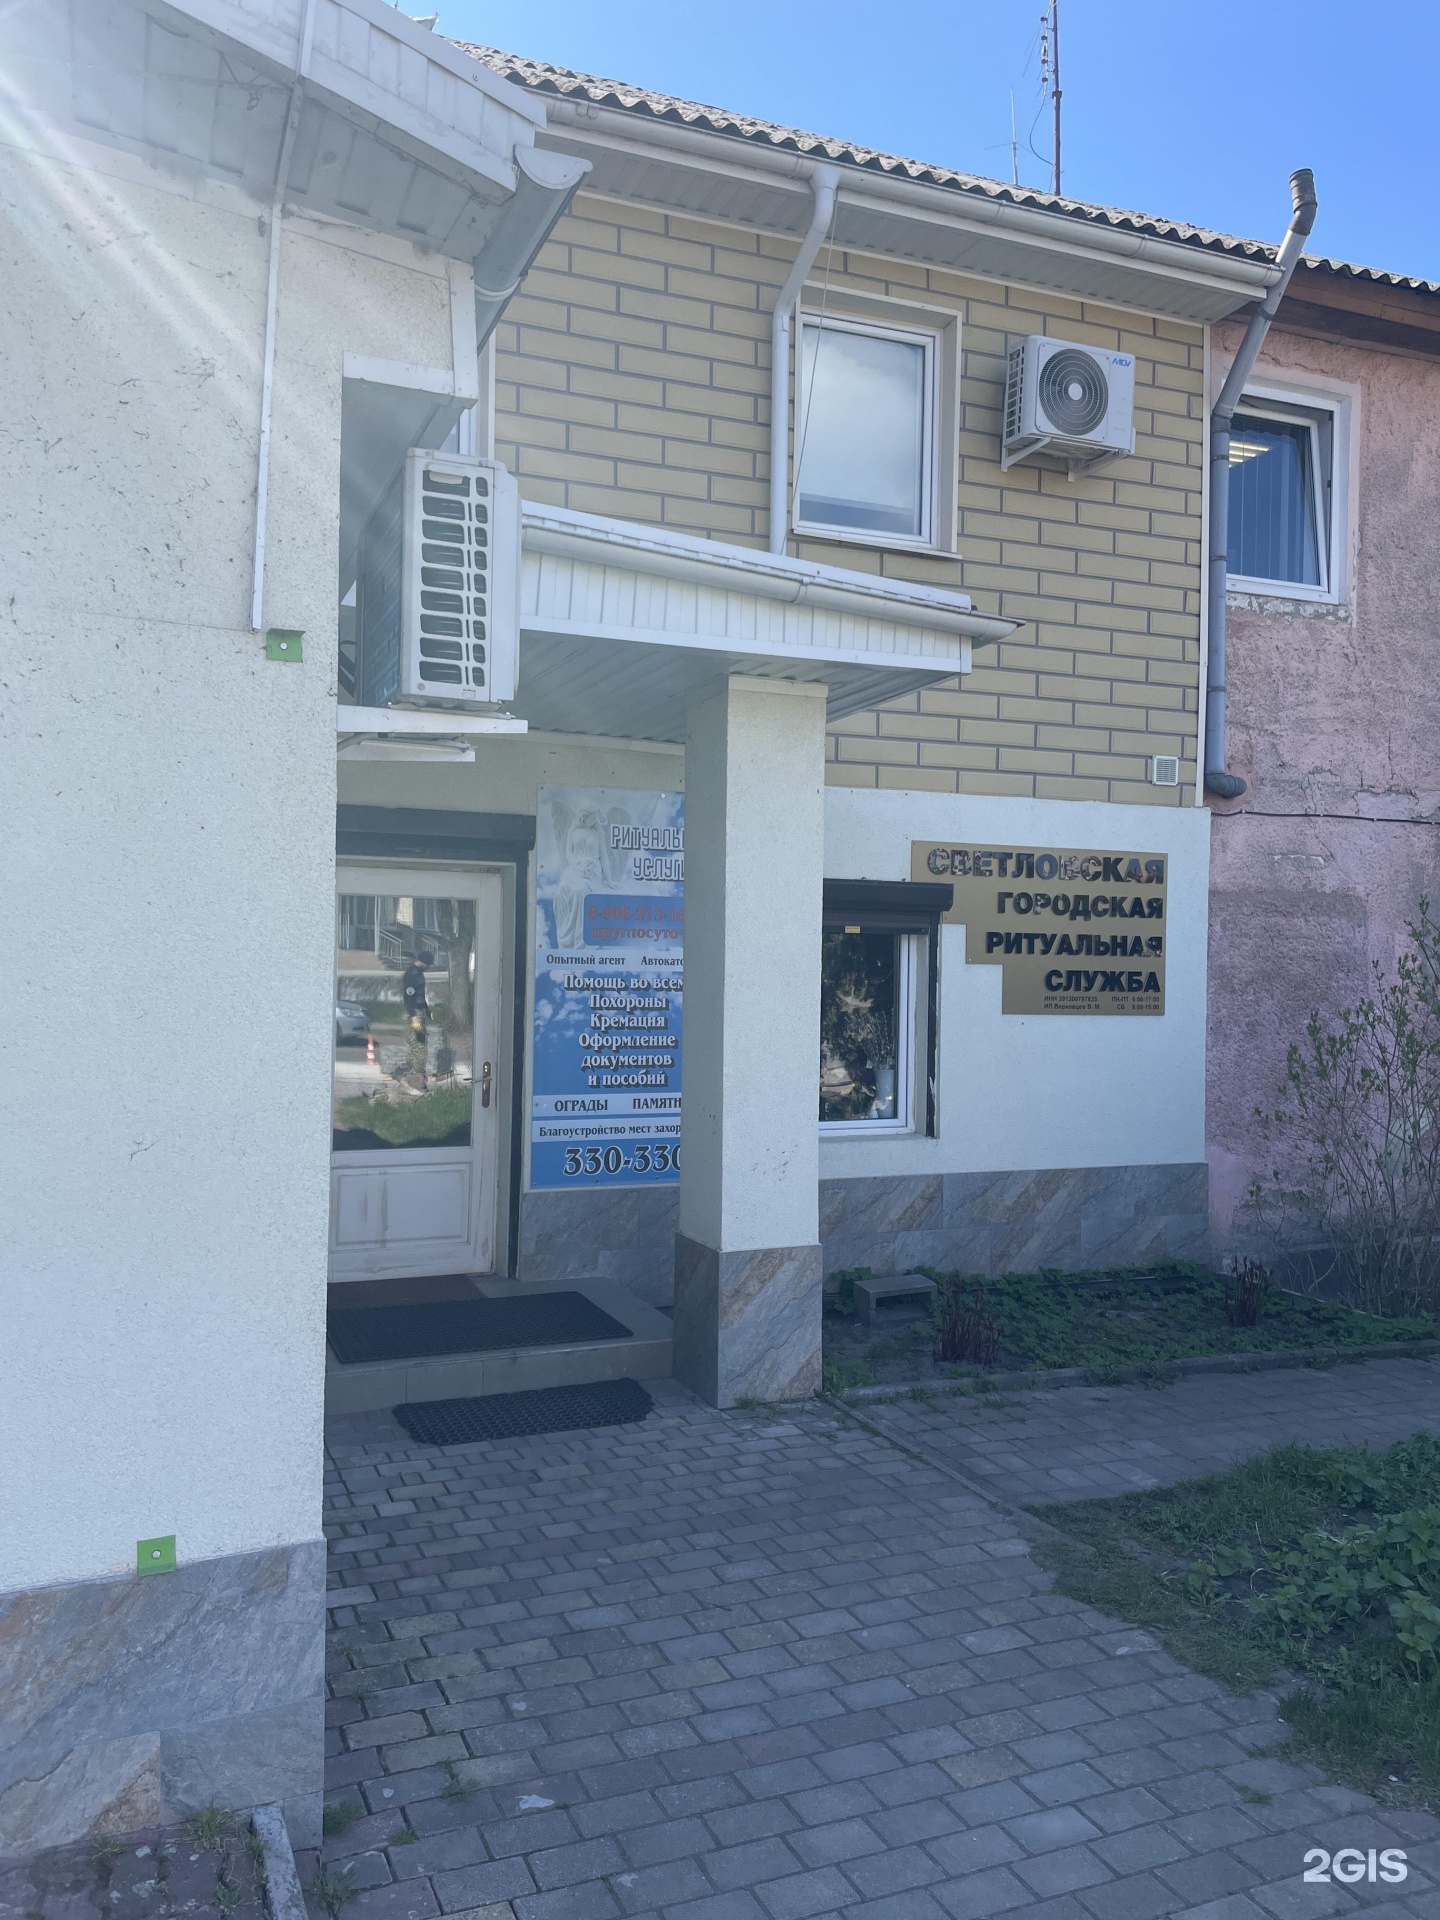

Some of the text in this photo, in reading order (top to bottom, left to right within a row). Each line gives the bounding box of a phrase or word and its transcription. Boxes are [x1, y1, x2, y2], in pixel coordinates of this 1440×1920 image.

[1111, 357, 1131, 367] MDV
[927, 848, 1164, 884] СВЕТЛОВСКАЯ
[997, 892, 1163, 921] ГОРОДСКАЯ
[986, 931, 1163, 957] РИТУАЛЬНАЯ
[546, 954, 595, 965] Опытный
[598, 957, 626, 966] агент
[563, 974, 626, 991] Помощь
[630, 978, 648, 989] во
[1045, 969, 1161, 992] СЛУЖБА
[589, 994, 667, 1011] Похороны
[590, 1013, 665, 1030] Кремация
[578, 1033, 676, 1050] Оформление
[581, 1054, 672, 1069] документов
[588, 1070, 666, 1086] и пособий
[554, 1097, 682, 1113] ОГРАДЫ ПАМЯТН
[539, 1124, 681, 1138] Благоустройство мест захор
